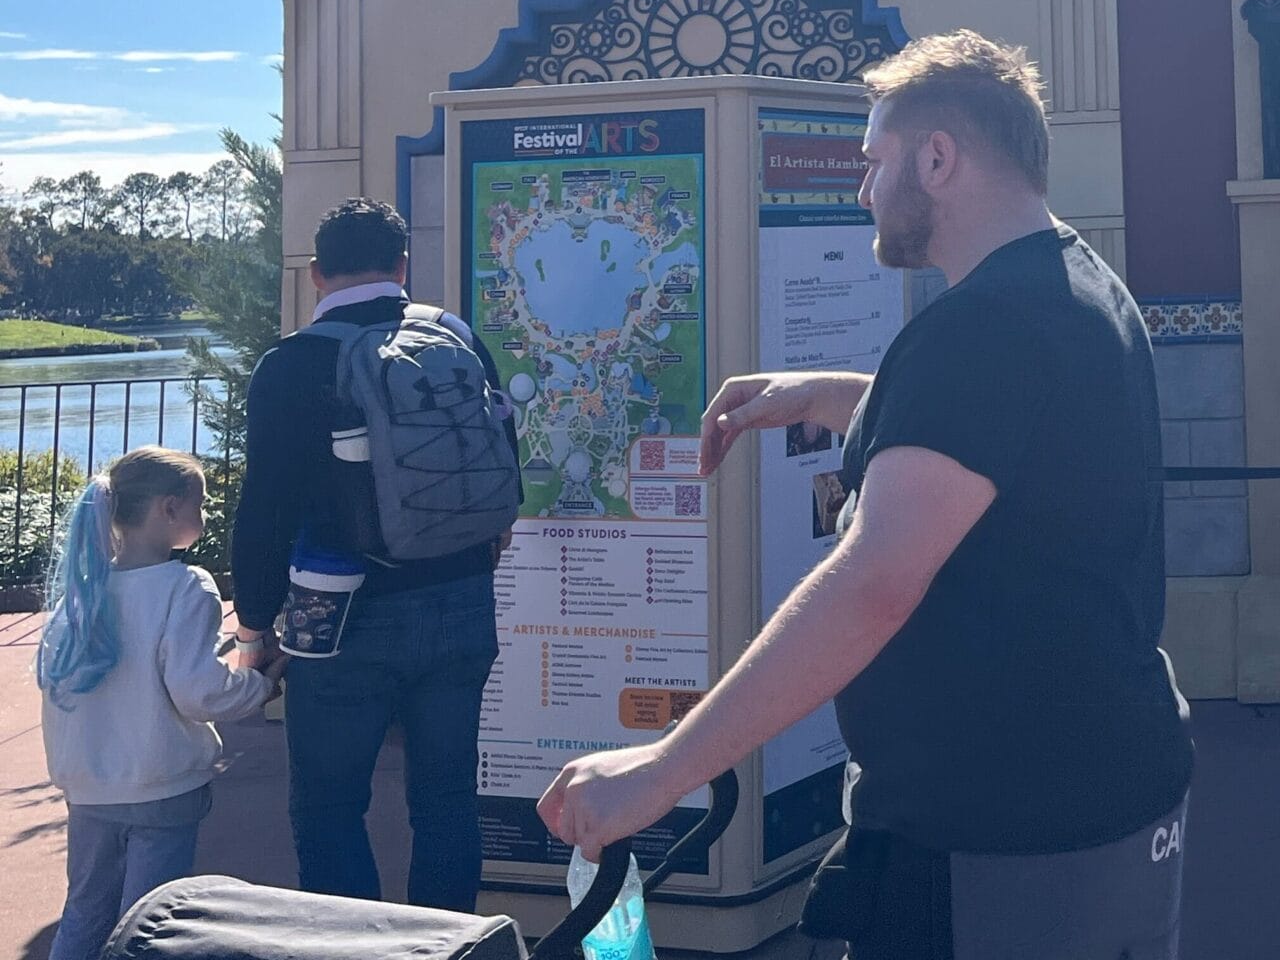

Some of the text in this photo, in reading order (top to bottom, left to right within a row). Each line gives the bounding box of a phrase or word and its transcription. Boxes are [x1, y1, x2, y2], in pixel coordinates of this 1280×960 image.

[529, 123, 577, 131] INTERNATIONAL
[513, 119, 660, 154] Festival ARTS
[769, 155, 870, 170] El Artista Hambri
[824, 251, 844, 262] MENU
[543, 528, 627, 539] FOOD STUDIOS
[512, 624, 656, 639] ARTISTS & MERCHANDISE
[624, 676, 697, 687] MEET THE ARTISTS
[536, 738, 631, 751] ENTERTAINMEN
[1151, 821, 1180, 862] CA
